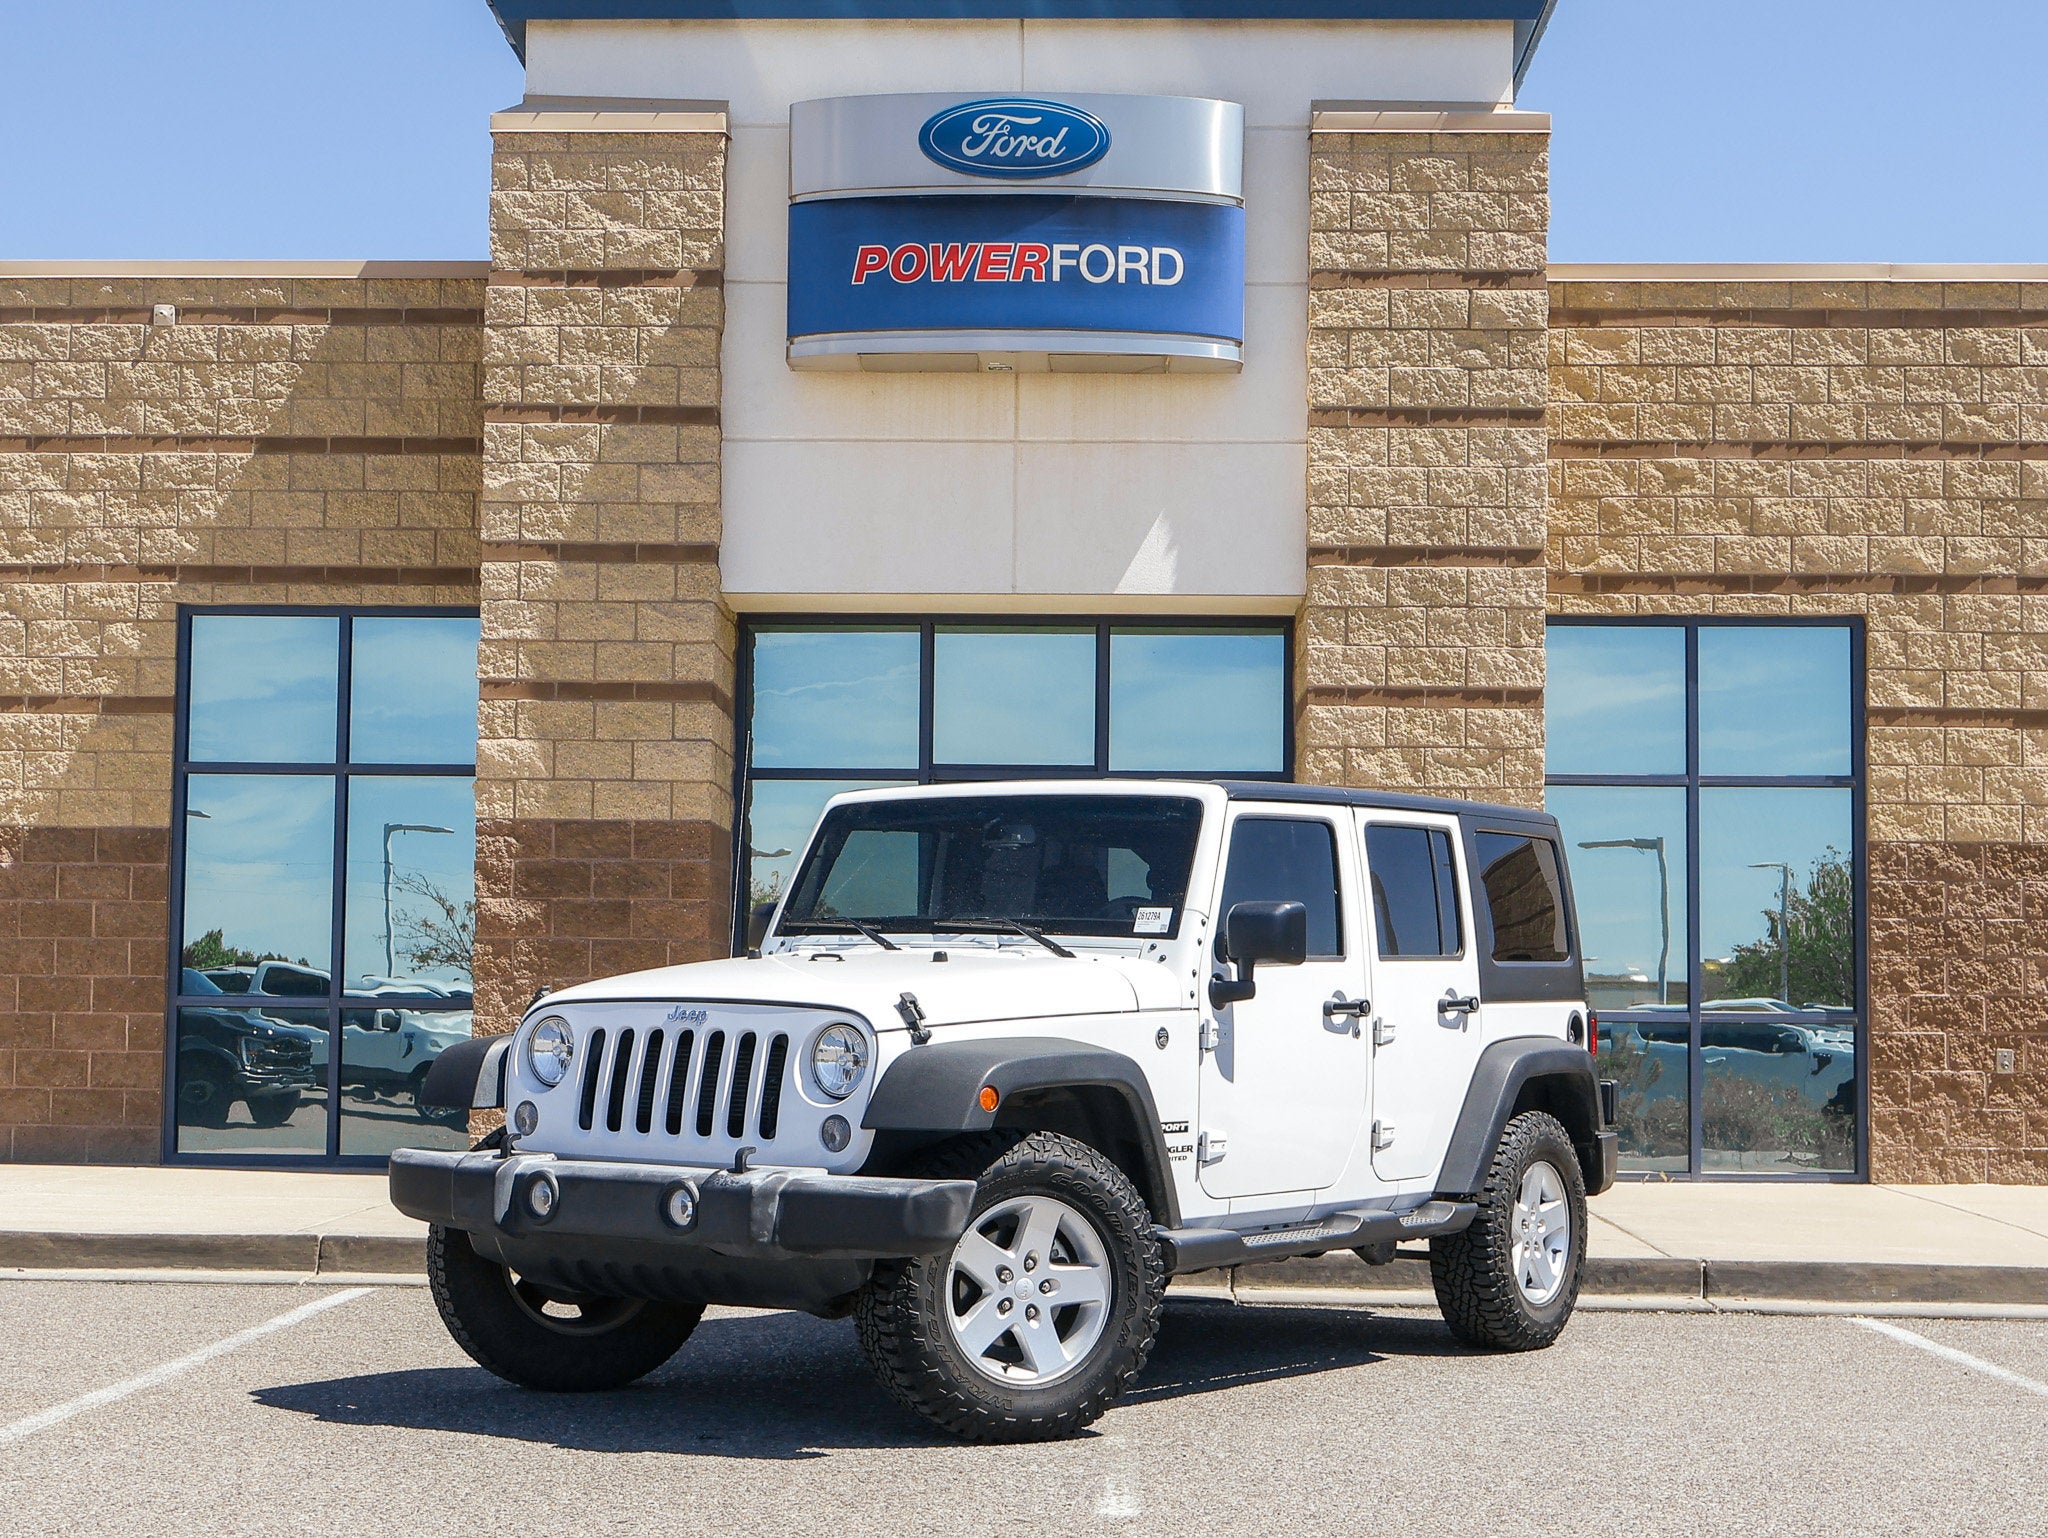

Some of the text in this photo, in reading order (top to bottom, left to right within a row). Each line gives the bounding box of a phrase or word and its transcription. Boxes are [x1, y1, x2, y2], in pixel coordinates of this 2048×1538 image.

[961, 113, 1069, 158] Ford
[667, 1005, 707, 1026] Jeep
[1161, 1122, 1187, 1132] PORT
[1167, 1145, 1193, 1153] GLER
